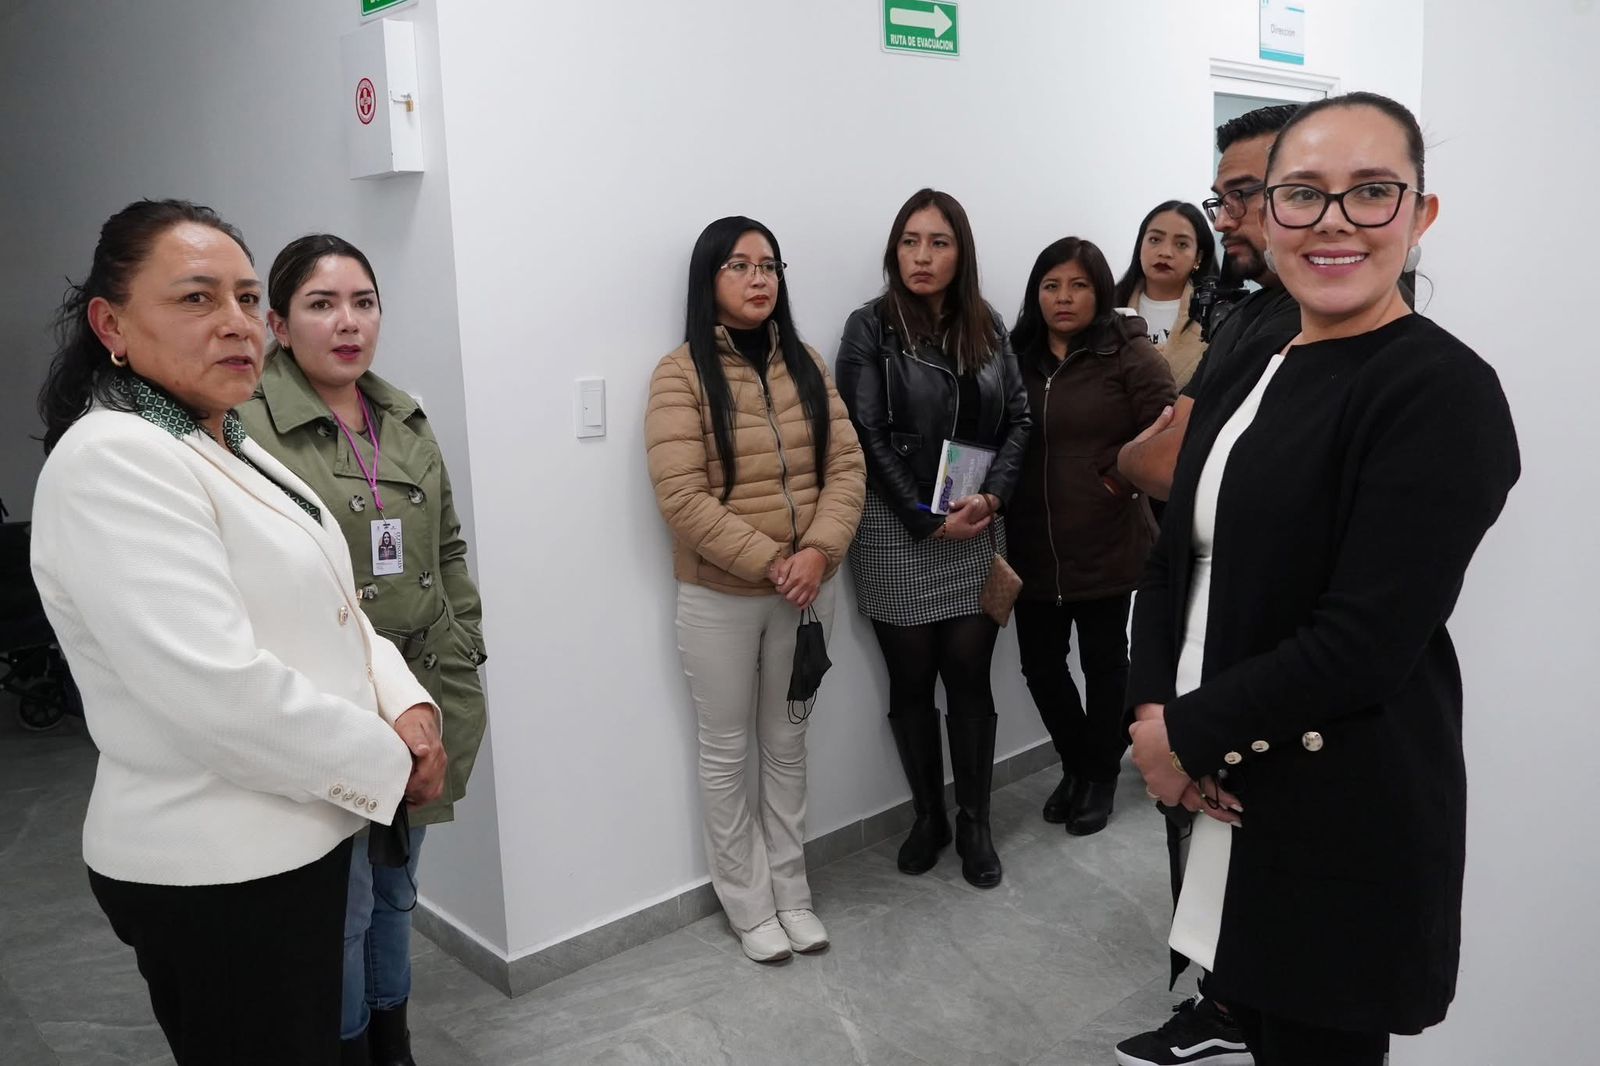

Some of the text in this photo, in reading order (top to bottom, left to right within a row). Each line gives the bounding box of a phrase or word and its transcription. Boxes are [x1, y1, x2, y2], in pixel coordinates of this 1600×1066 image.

[891, 35, 954, 51] RUTA DE EVACUACION
